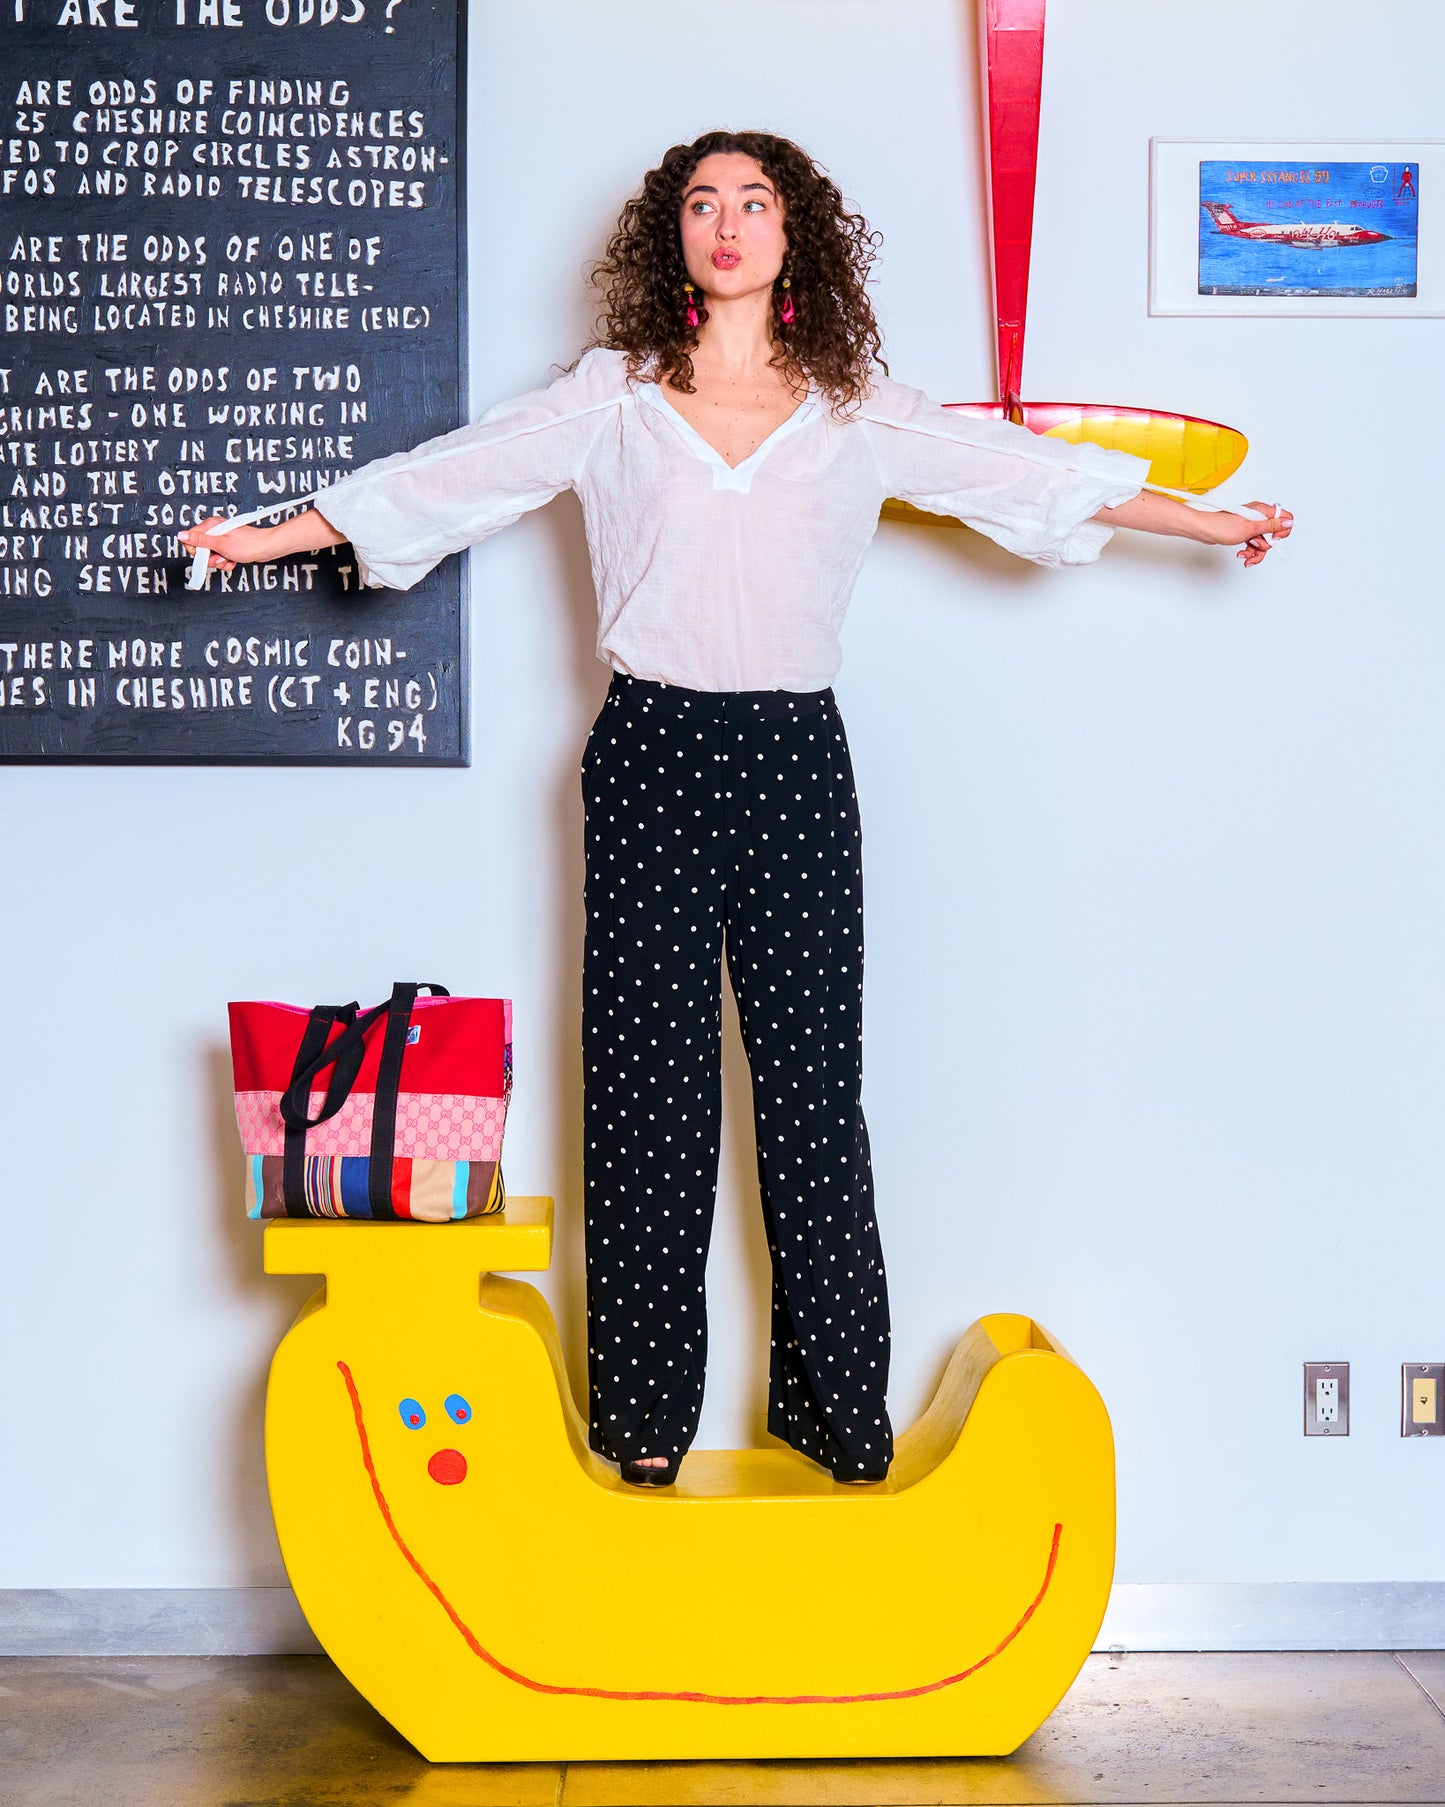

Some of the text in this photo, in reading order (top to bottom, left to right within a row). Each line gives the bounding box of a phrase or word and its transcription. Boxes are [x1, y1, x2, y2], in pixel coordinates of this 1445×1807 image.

[57, 0, 139, 28] ARE
[15, 78, 350, 107] ARE ODDS OF FINDING
[15, 107, 424, 139] 25 CHESHIRE COINCIDENCES
[0, 139, 449, 173] ED TO CROP CIRCLES ASTRON-
[3, 168, 425, 208] FOS AND RADIO TELESCOPES
[9, 231, 381, 266] ARE THE ODDS OF ONE OF
[0, 270, 374, 298] ORLDS LARGEST RADIO TELE-
[5, 301, 430, 334] BEING LOCATED IN CHESHIRE (ENG)
[34, 369, 88, 397] ARE
[104, 366, 156, 393] THE
[168, 366, 230, 393] ODDS
[246, 367, 278, 392] OF
[292, 364, 361, 393] TWO
[131, 402, 187, 428] ONE
[208, 401, 325, 427] WORKING
[340, 400, 367, 425] IN
[54, 438, 160, 466] LOTTERY
[180, 439, 205, 462] IN
[225, 435, 354, 463] CHESHIRE
[11, 471, 66, 498] AND
[86, 470, 138, 495] THE
[158, 469, 239, 496] OTHER
[2, 501, 124, 530] LARGEST
[64, 535, 88, 561] IN
[0, 567, 52, 597] ING
[78, 564, 168, 594] SEVEN
[0, 636, 407, 673] THERE MORE COSMIC COIN-
[68, 677, 96, 708] IN
[116, 675, 253, 710] CHESHIRE
[267, 674, 322, 714] (CT
[364, 671, 438, 711] ENG)
